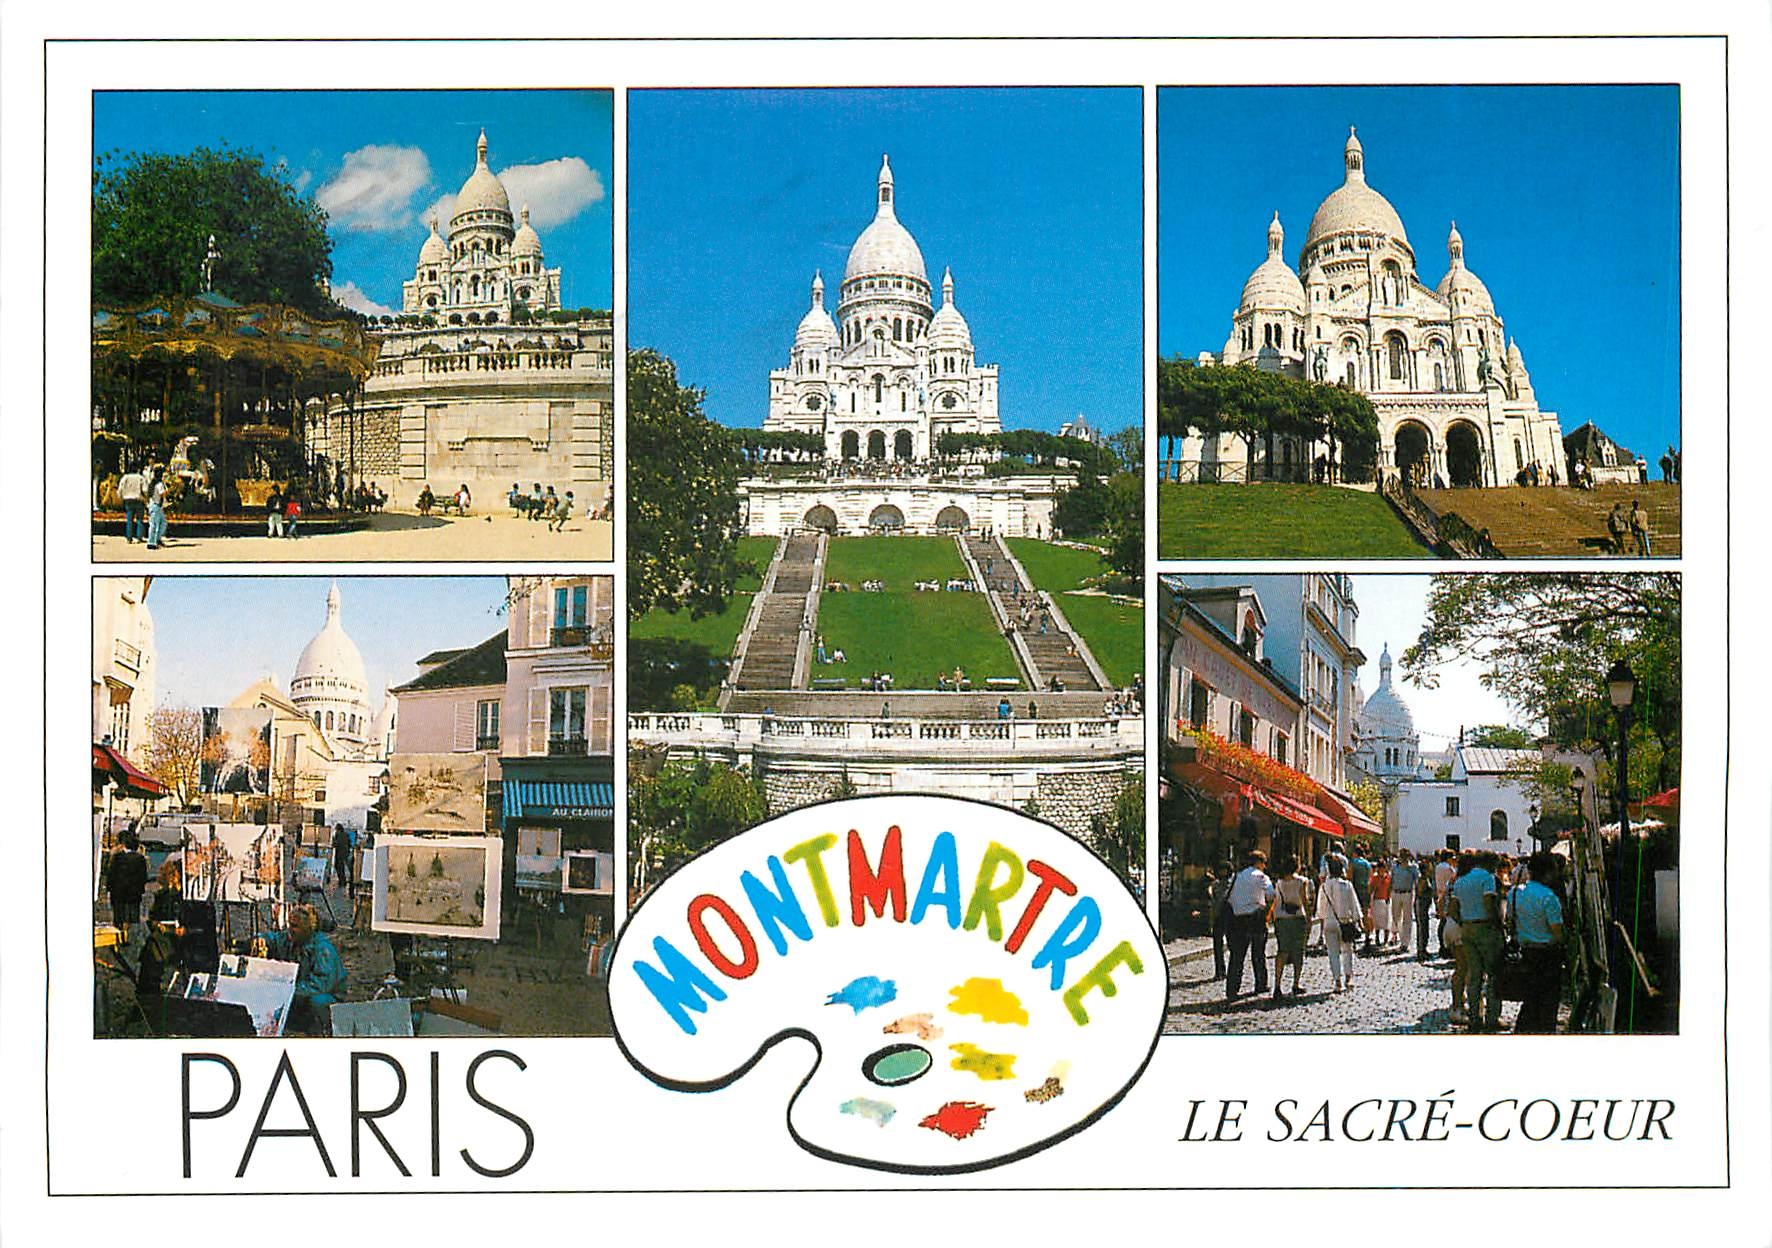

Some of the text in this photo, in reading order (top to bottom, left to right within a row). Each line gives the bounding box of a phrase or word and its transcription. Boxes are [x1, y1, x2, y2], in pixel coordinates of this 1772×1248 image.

[552, 808, 568, 817] AU
[632, 825, 1144, 1035] MONTMARTRE
[182, 1050, 534, 1178] PARIS
[1178, 1090, 1675, 1143] LE SACRÉ-COEUR
